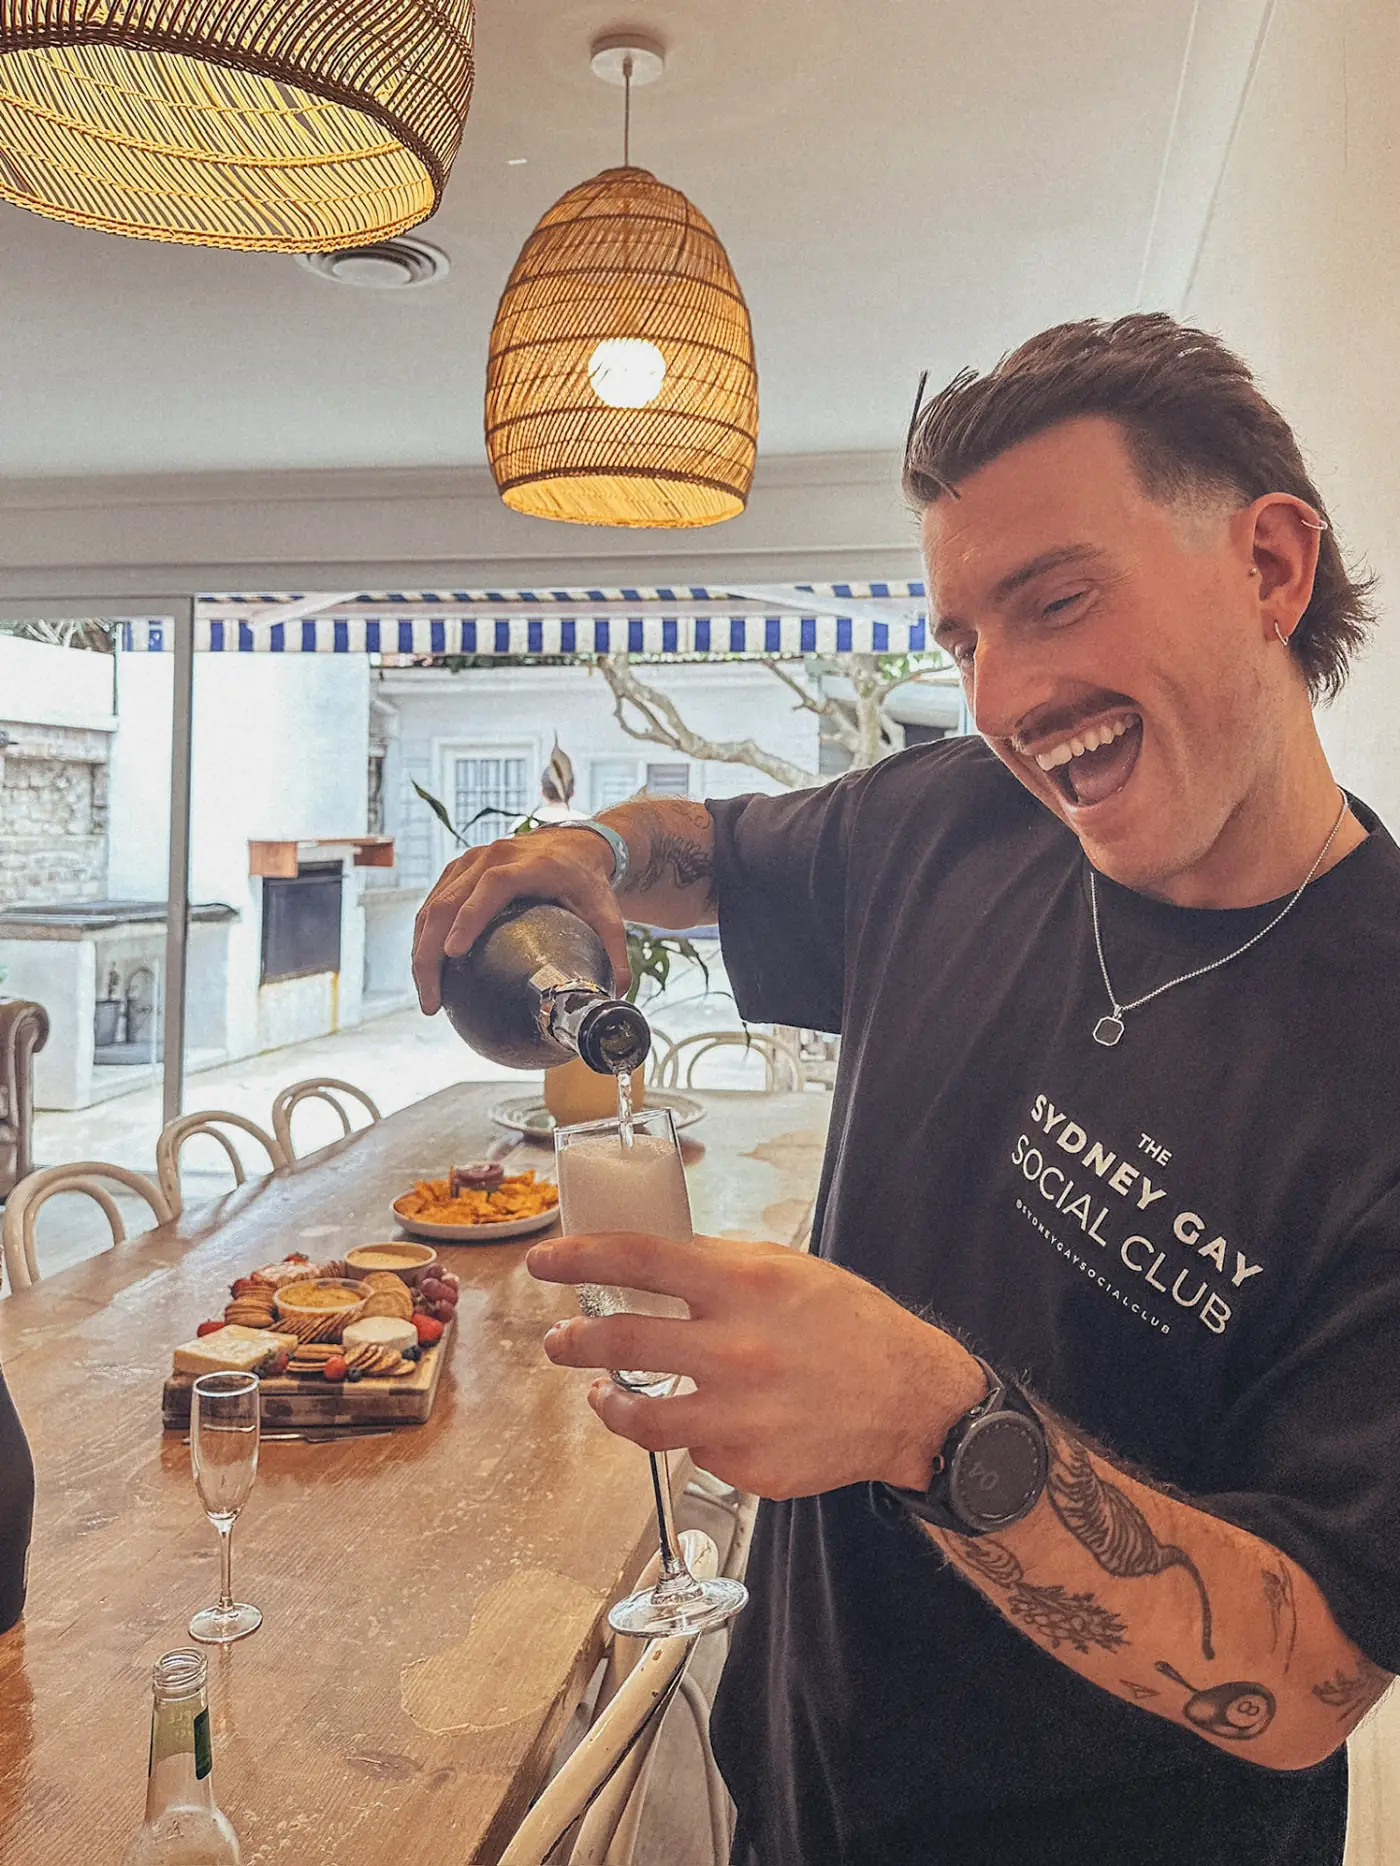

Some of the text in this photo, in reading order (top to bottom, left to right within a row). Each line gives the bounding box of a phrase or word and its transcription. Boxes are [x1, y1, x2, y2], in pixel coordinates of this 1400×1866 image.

[1030, 1093, 1264, 1287] SYDNEY GAY
[1137, 1132, 1173, 1167] THE
[1011, 1134, 1232, 1334] SOCIAL CLUB
[1015, 1198, 1171, 1334] @SYDNEYGAYSOCIALCLUB
[1237, 1700, 1260, 1716] 8
